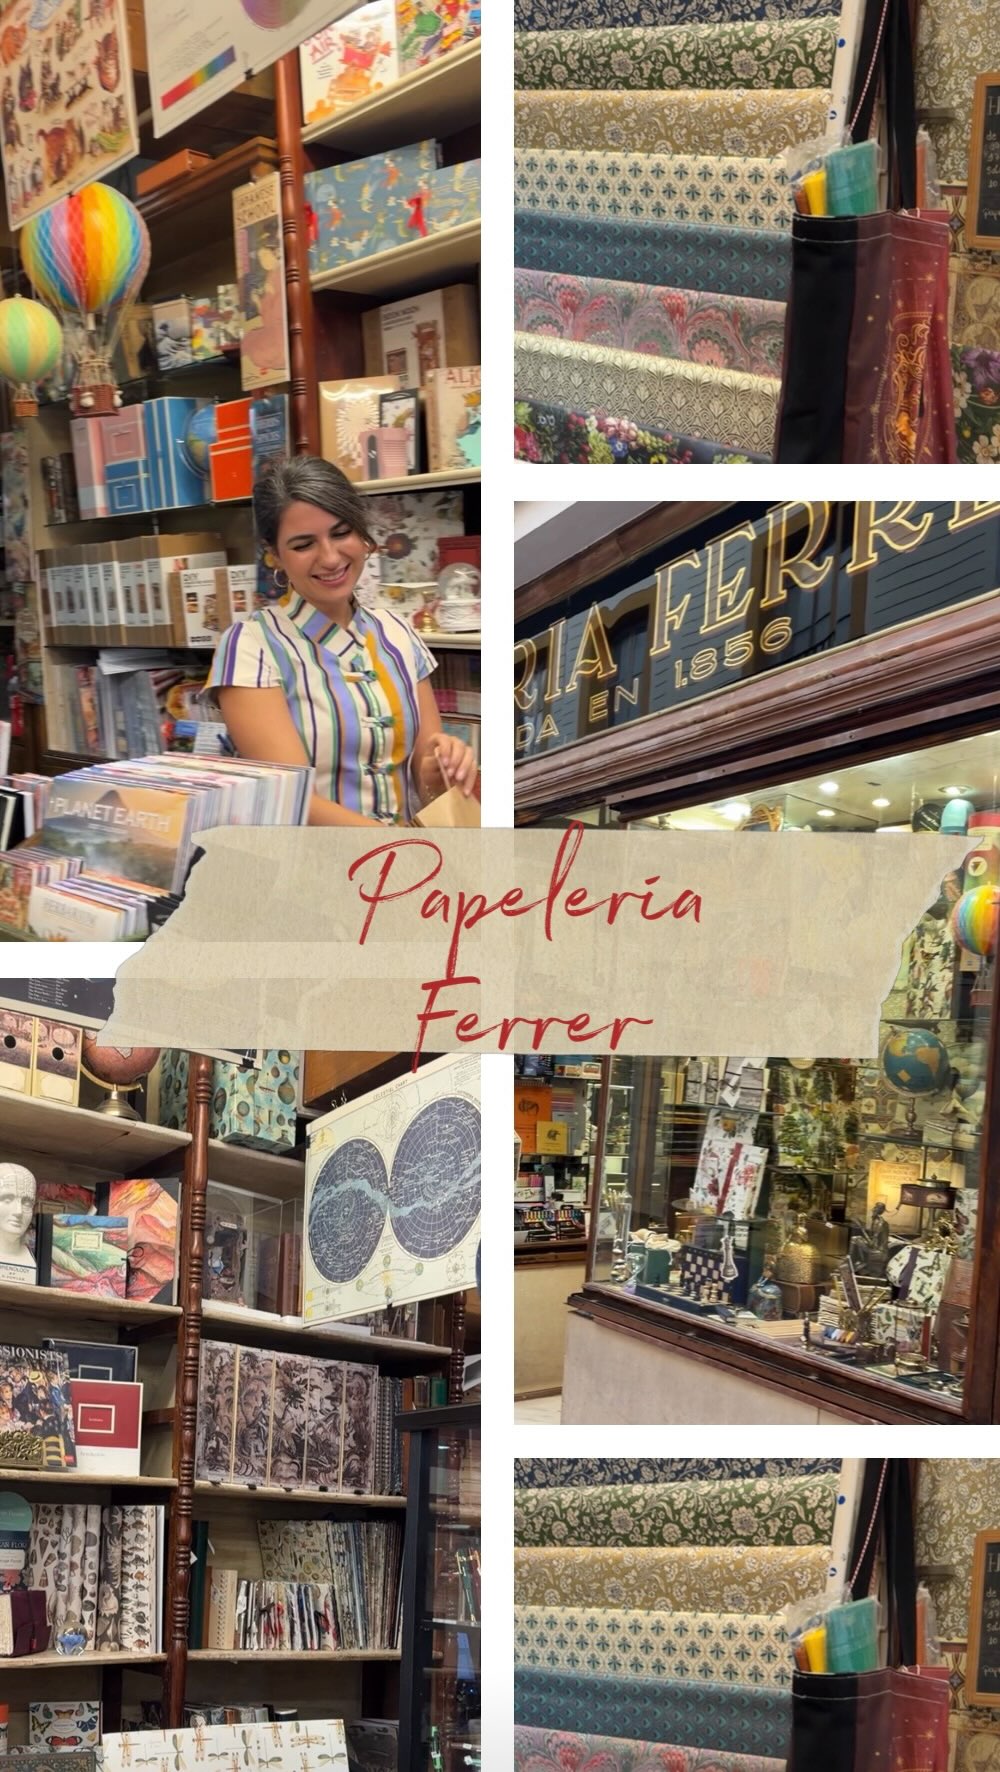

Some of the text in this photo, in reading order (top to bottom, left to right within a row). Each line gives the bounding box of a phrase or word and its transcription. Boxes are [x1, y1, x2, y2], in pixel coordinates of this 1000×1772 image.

[589, 677, 640, 723] EN
[55, 797, 112, 823] PLANET
[113, 807, 171, 833] EARTH
